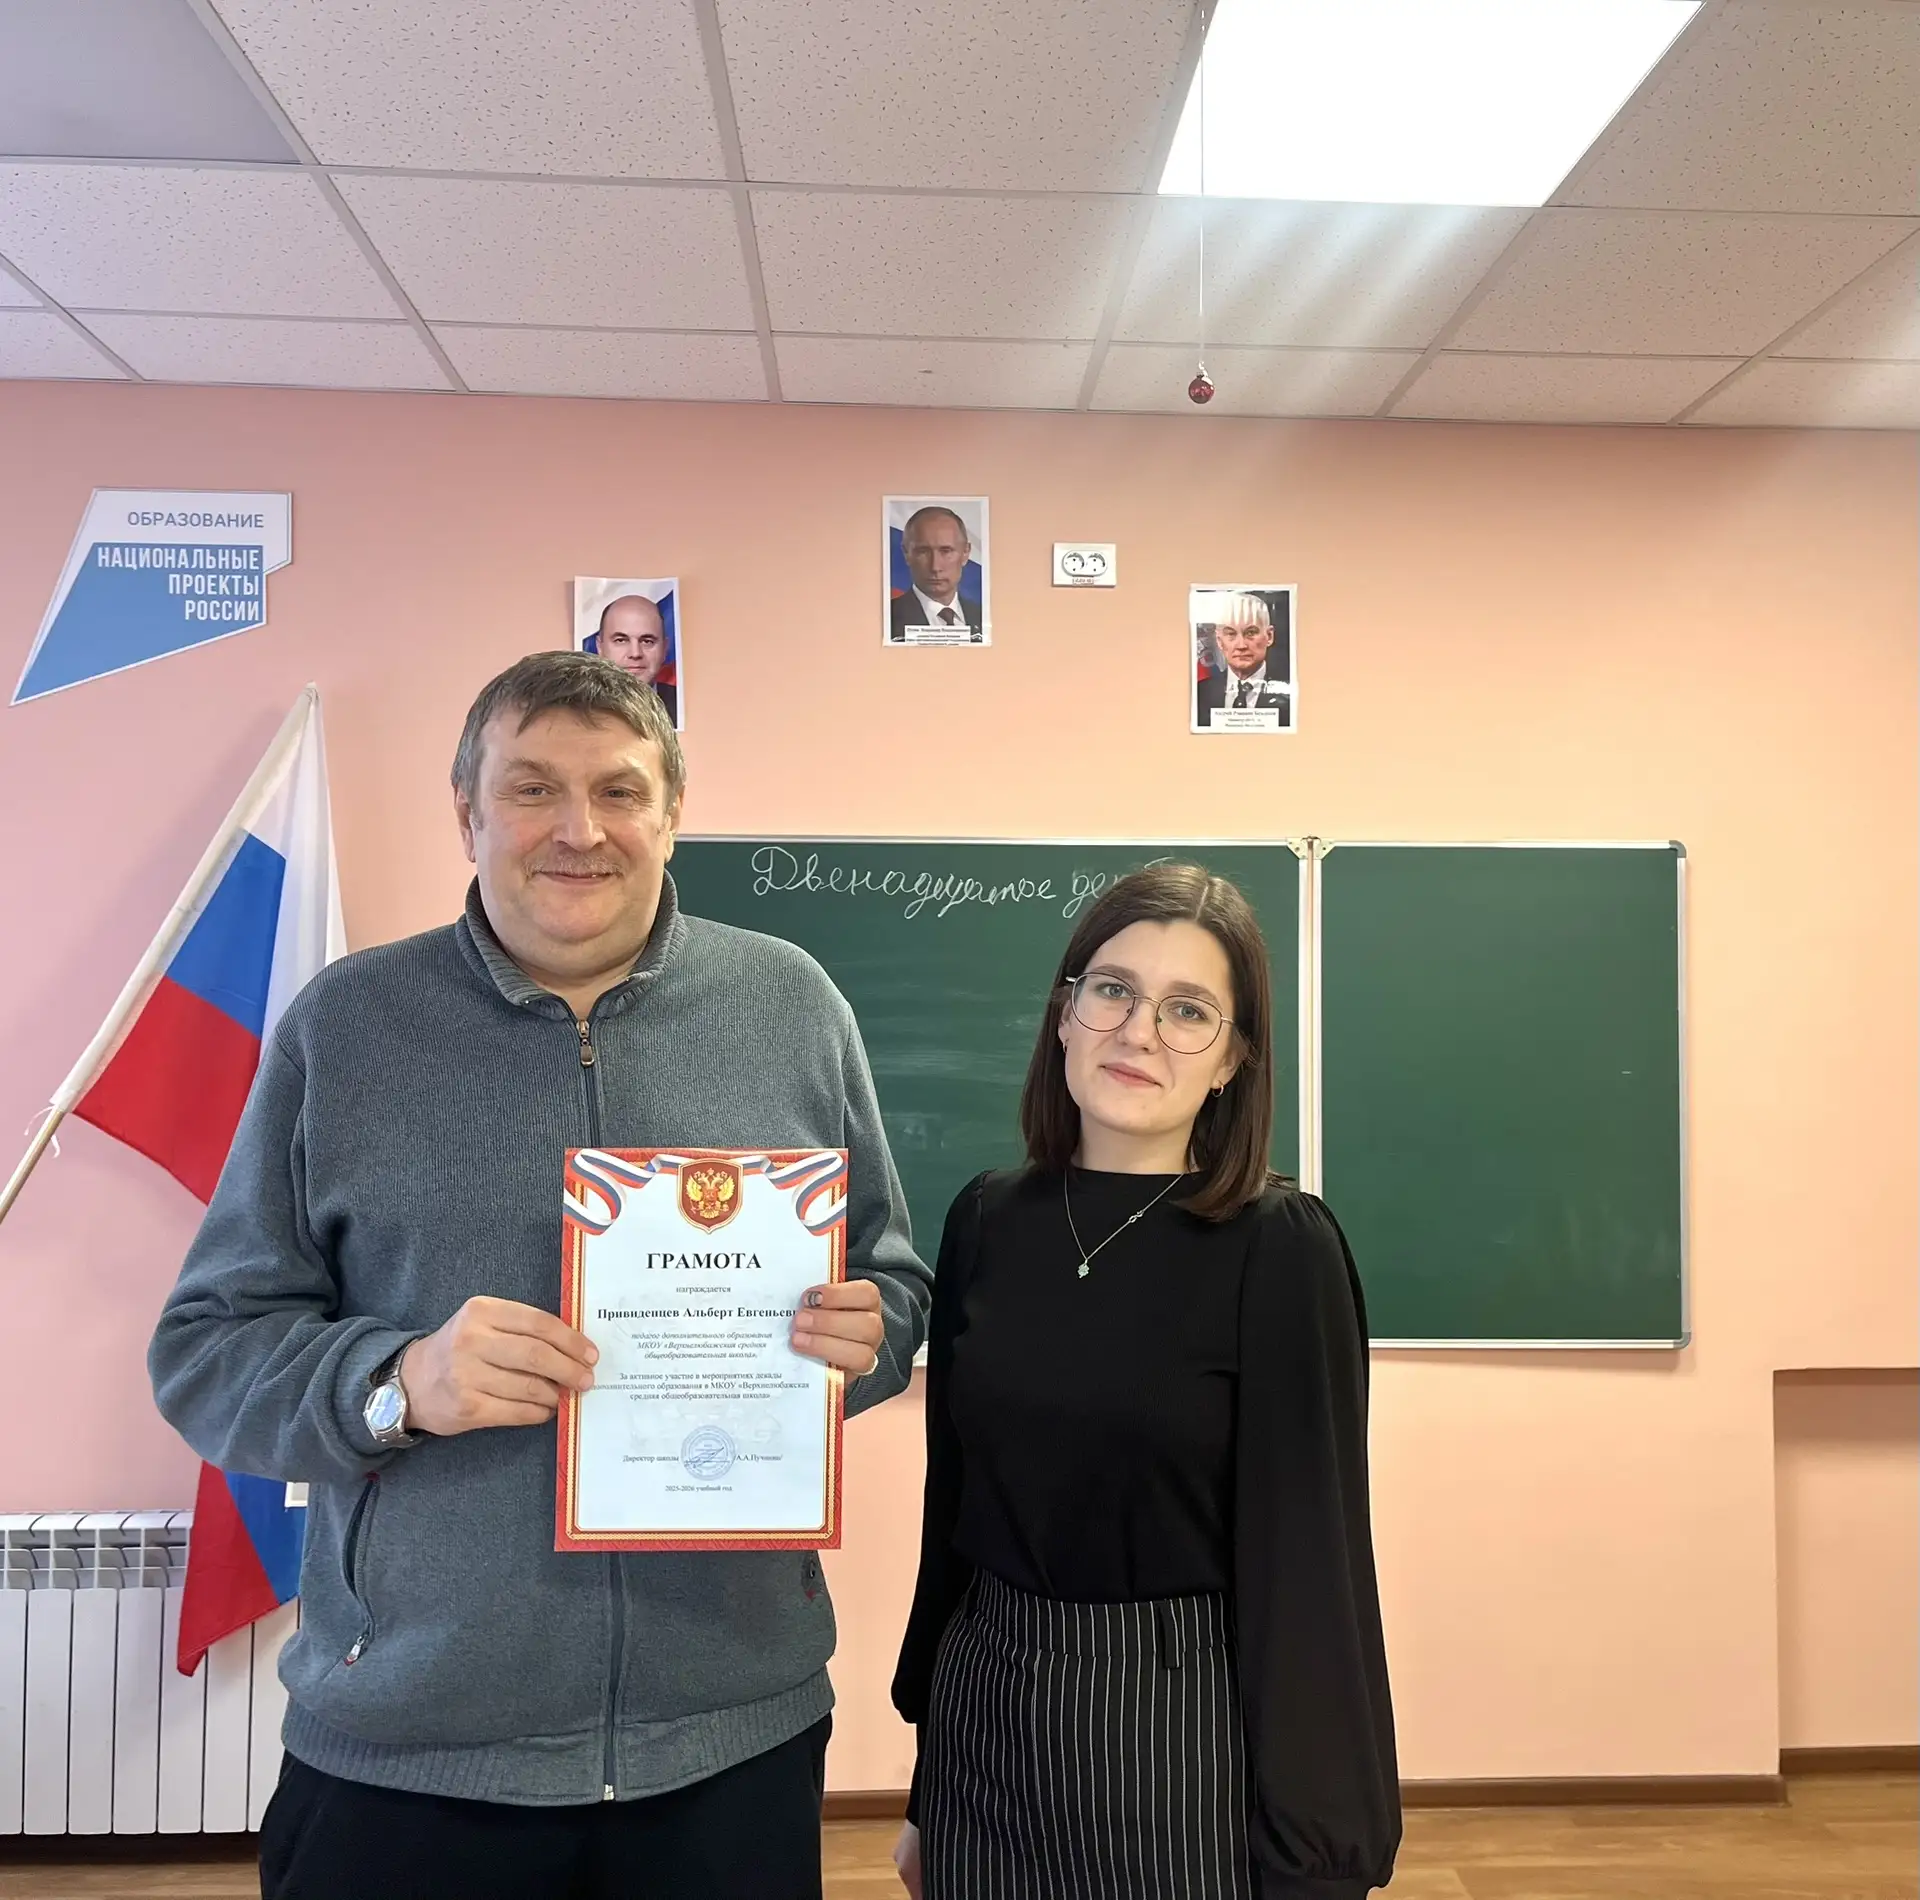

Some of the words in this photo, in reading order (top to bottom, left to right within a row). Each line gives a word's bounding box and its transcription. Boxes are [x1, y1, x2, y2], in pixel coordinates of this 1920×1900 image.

[127, 511, 265, 528] ОБРАЗОВАНИЕ
[97, 546, 260, 571] НАЦИОНАЛЬНЫЕ
[168, 573, 260, 596] ПРОЕКТЫ
[184, 599, 260, 621] РОССИИ
[751, 845, 1057, 919] Двенадцатое
[645, 1252, 762, 1269] ГРАМОТА
[675, 1285, 732, 1294] награждается
[597, 1308, 680, 1321] Привиденцев
[683, 1306, 733, 1320] Альберт
[737, 1306, 796, 1318] Евгеньев
[726, 1331, 773, 1341] образования
[637, 1341, 662, 1349] МКОУ
[737, 1341, 767, 1351] средняя
[644, 1351, 727, 1360] общеобразовательная
[619, 1372, 628, 1380] За
[665, 1373, 694, 1382] участие
[701, 1373, 754, 1382] мероприятиях
[755, 1373, 782, 1381] декады
[656, 1381, 703, 1391] образования
[710, 1381, 737, 1389] МКОУ
[629, 1393, 660, 1402] средняя
[662, 1391, 741, 1401] общеобразовательная
[742, 1392, 771, 1400] школа»
[622, 1454, 656, 1463] Директор
